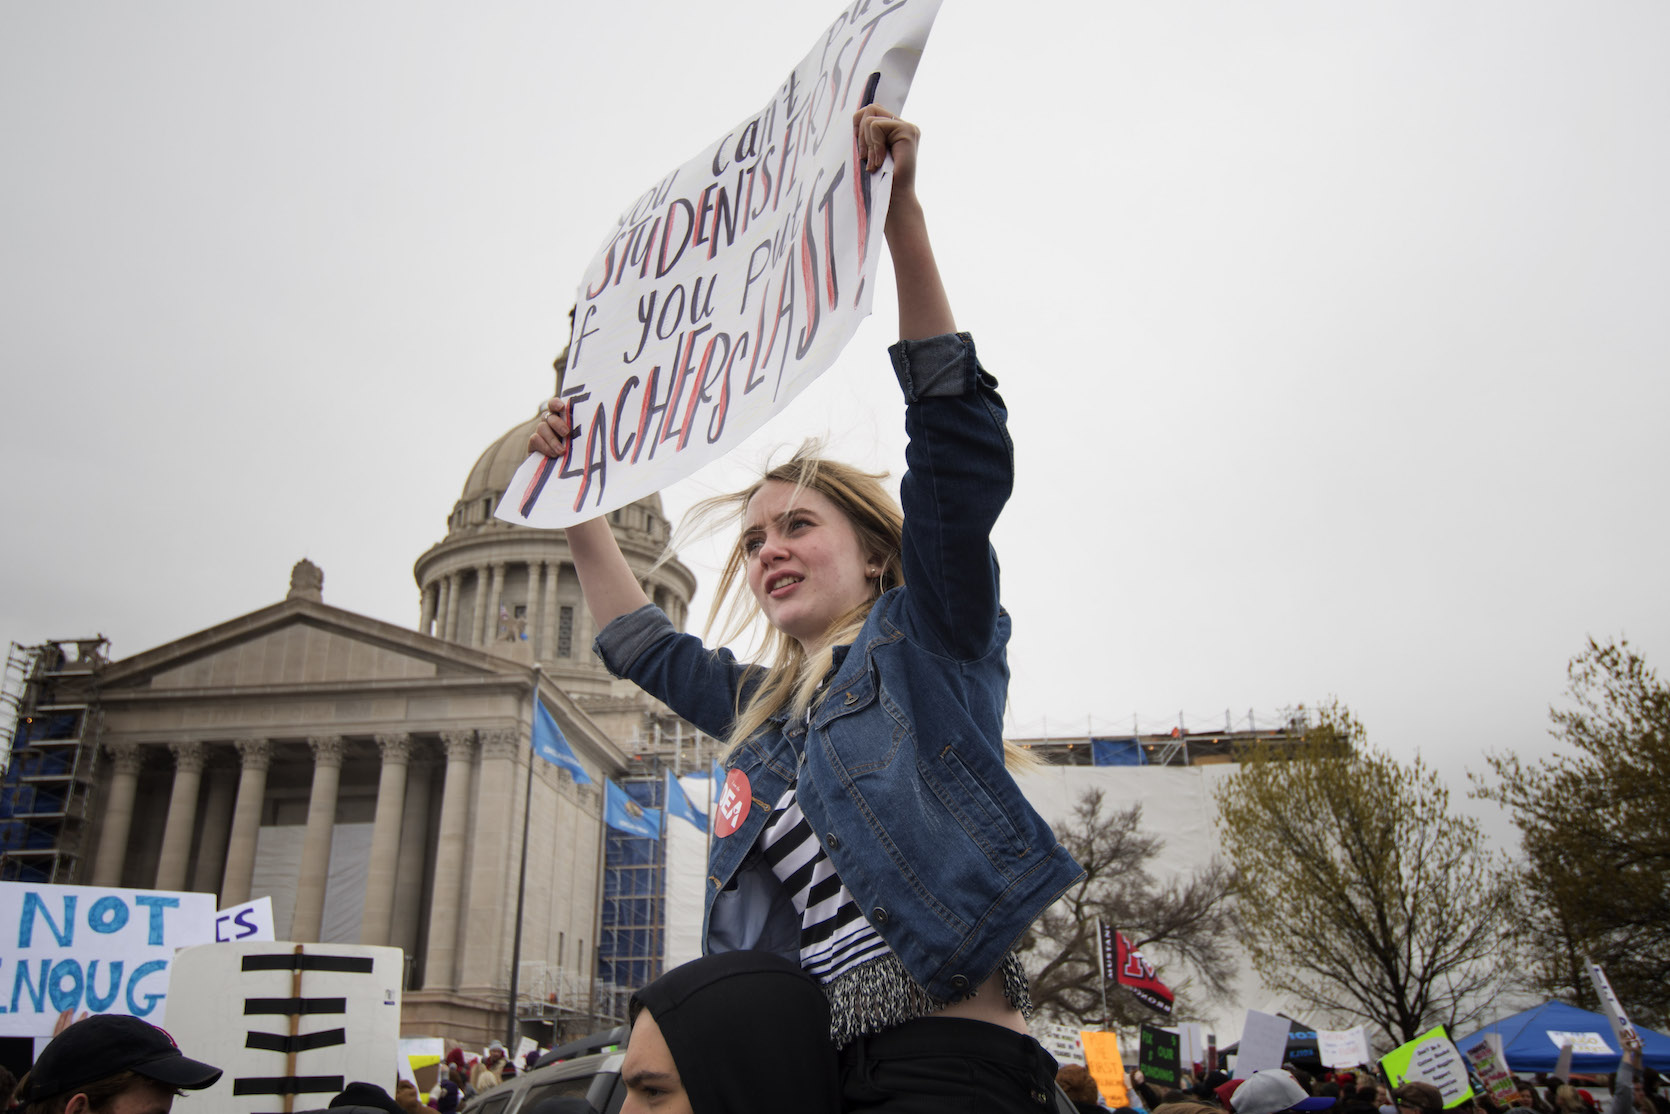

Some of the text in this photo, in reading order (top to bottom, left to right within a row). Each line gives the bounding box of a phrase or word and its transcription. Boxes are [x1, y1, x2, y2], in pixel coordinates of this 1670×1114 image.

[820, 0, 895, 75] pu
[586, 0, 908, 300] STUDENTS FIRST
[623, 273, 715, 364] you
[17, 892, 181, 948] NOT
[0, 958, 169, 1017] NOUG
